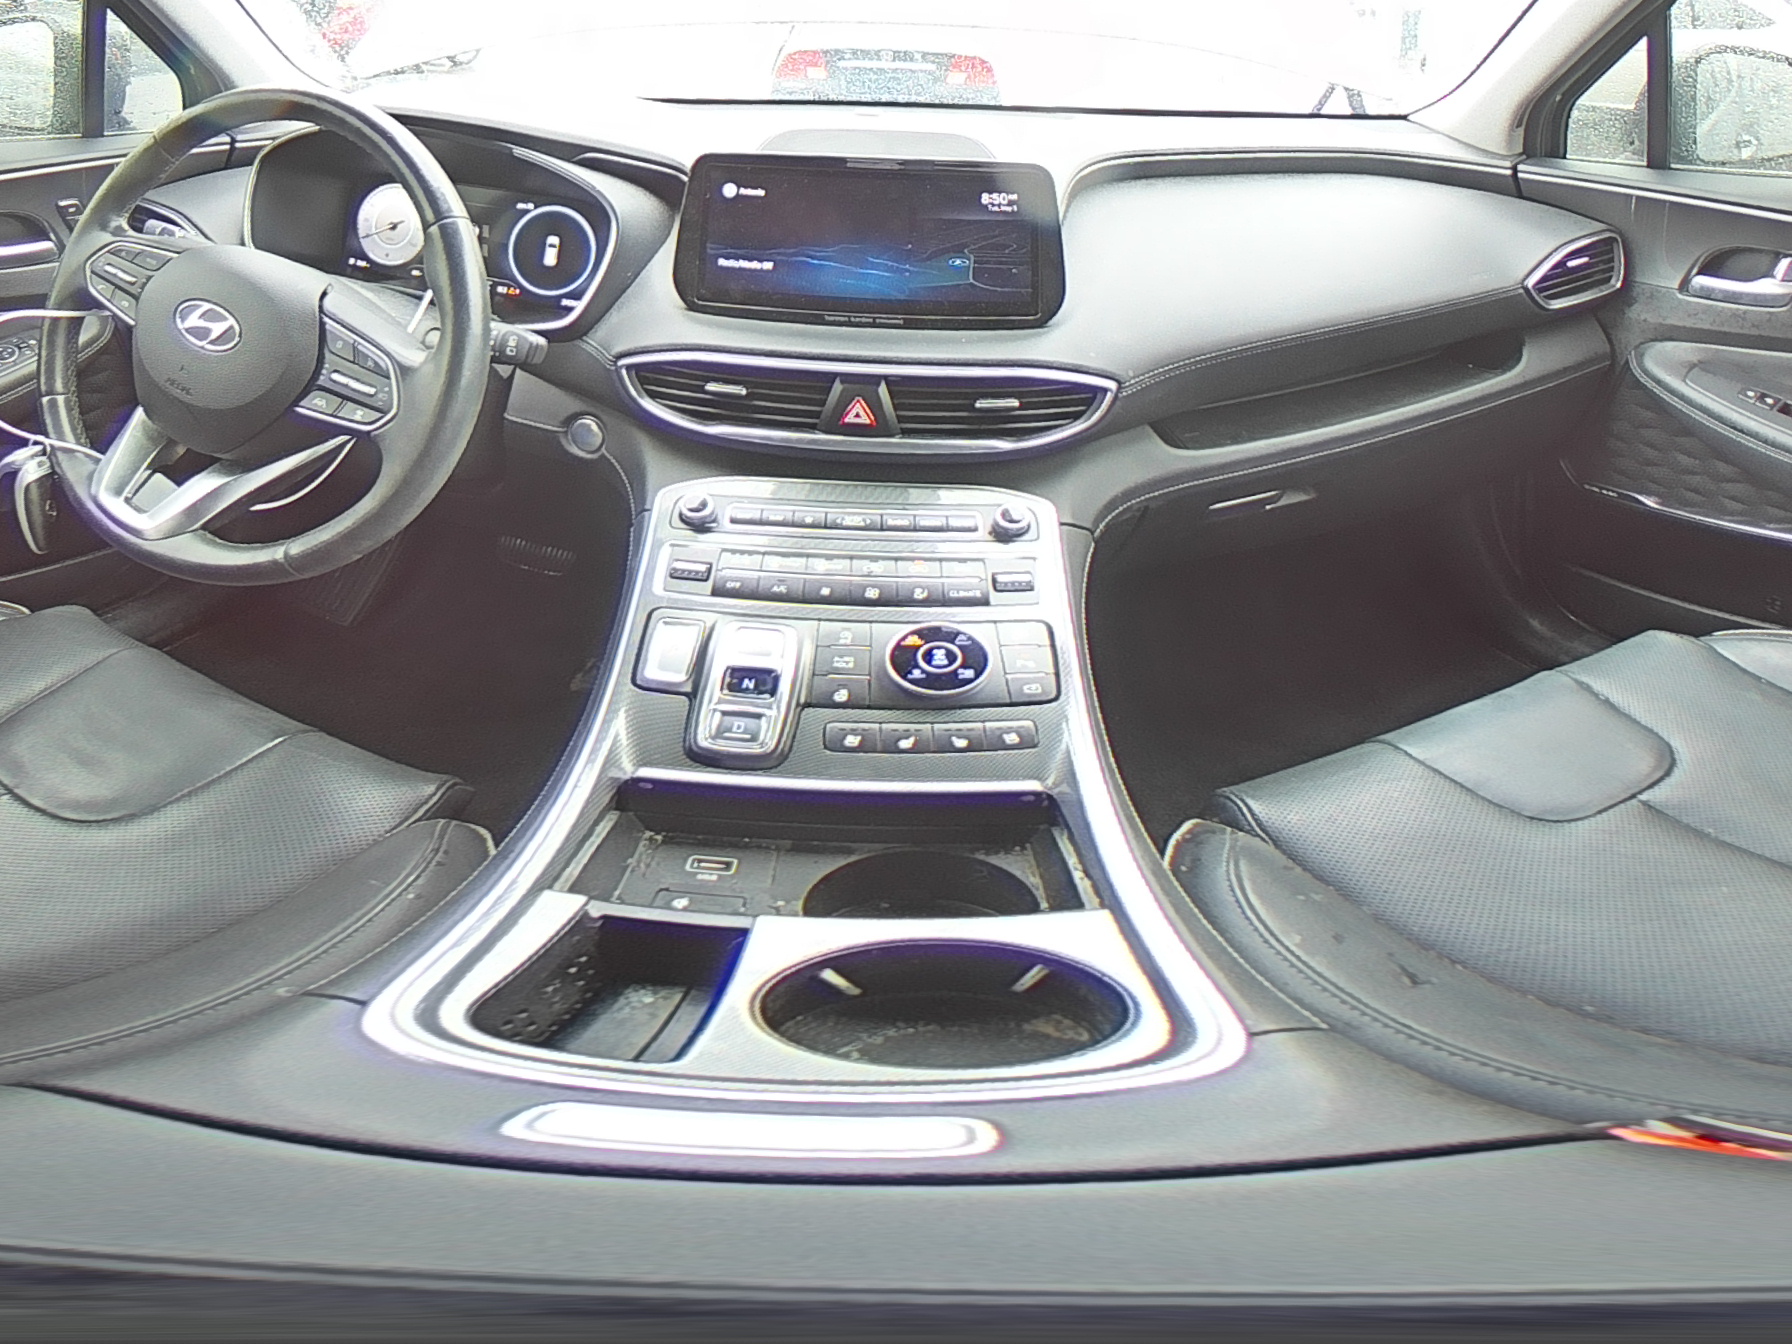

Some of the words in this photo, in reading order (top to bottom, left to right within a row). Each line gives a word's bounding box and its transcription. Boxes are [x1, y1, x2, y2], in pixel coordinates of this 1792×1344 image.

[981, 192, 1008, 205] 8:50
[741, 678, 755, 689] N
[731, 721, 745, 732] D
